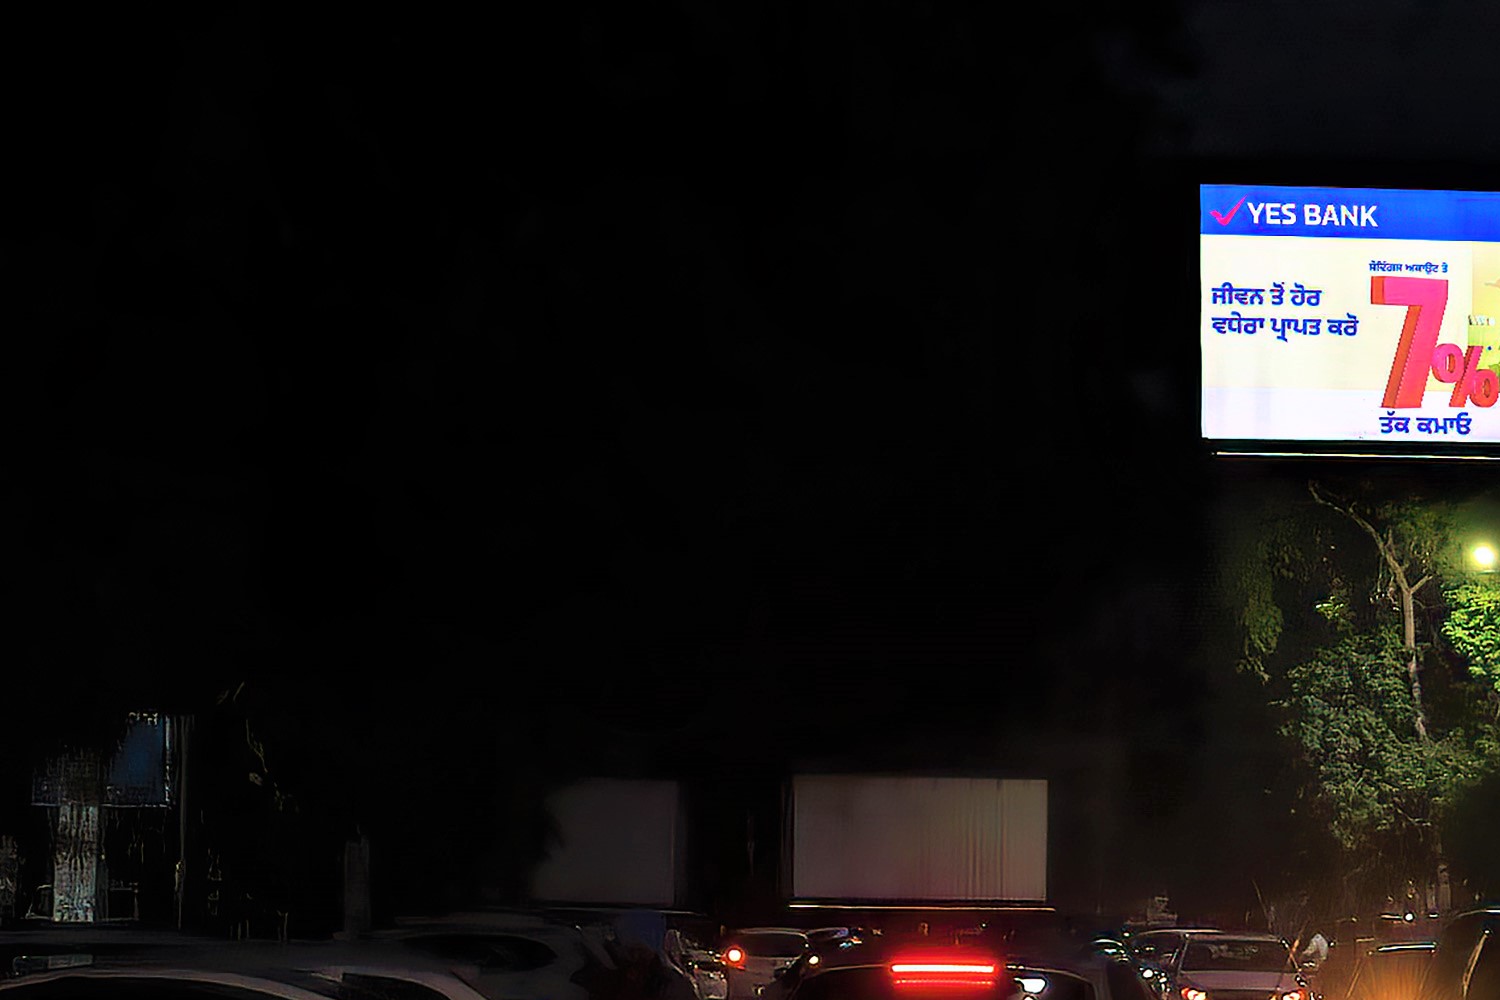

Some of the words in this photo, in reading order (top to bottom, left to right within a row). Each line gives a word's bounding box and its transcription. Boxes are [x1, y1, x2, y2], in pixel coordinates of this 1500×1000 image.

[1247, 202, 1296, 225] YES
[1304, 204, 1378, 227] BANK
[1211, 282, 1265, 305] ਜੀਵਨ
[1269, 282, 1285, 306] ਤੋਂ
[1290, 283, 1322, 306] ਹੋਰ
[1211, 311, 1265, 334] ਵਧੇਰਾ
[1270, 317, 1321, 342] ਪ੍ਰਾਪਤ
[1327, 313, 1359, 336] ਕਰੋ
[1379, 411, 1410, 434] ਤੱਕ
[1416, 412, 1472, 435] ਕਮਾਓ
